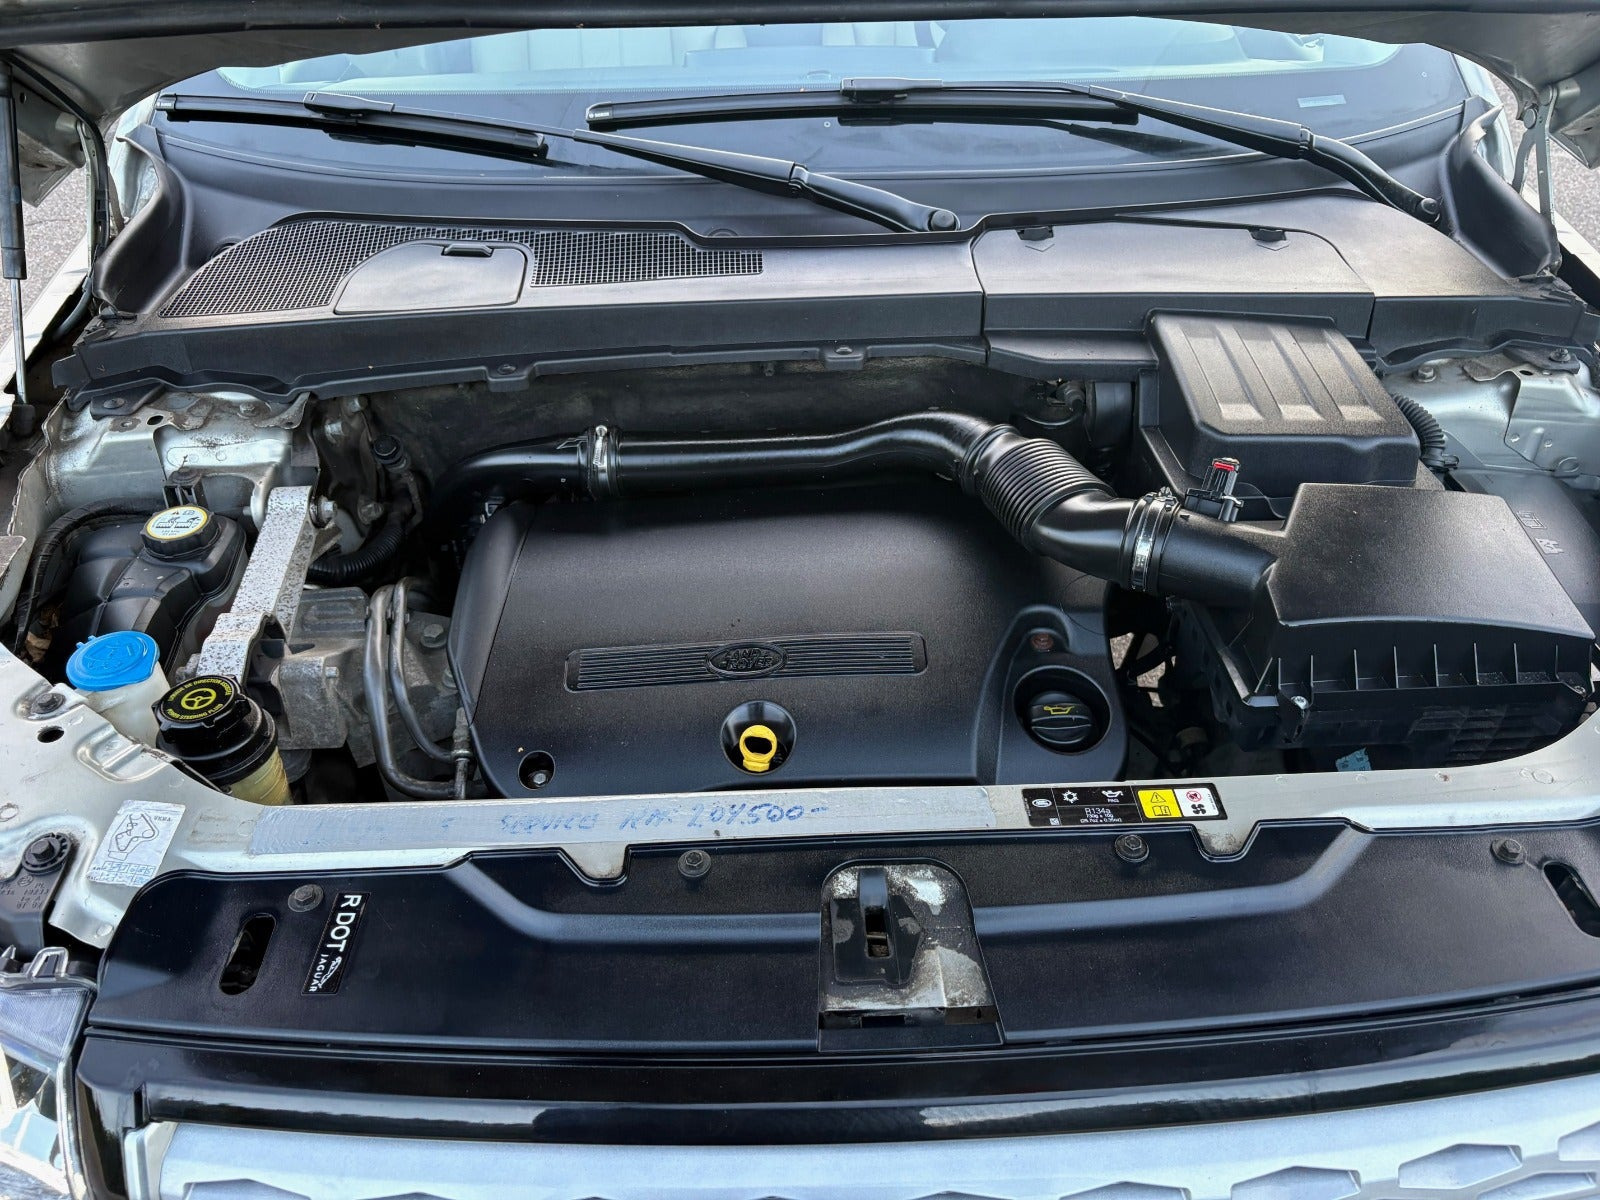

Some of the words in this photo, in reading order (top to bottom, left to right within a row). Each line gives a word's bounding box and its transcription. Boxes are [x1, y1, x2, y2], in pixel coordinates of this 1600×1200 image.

[725, 648, 761, 658] LAND
[725, 657, 773, 670] ROVER
[341, 894, 362, 908] R
[326, 912, 357, 952] DOT
[308, 954, 329, 992] JAGUAR
